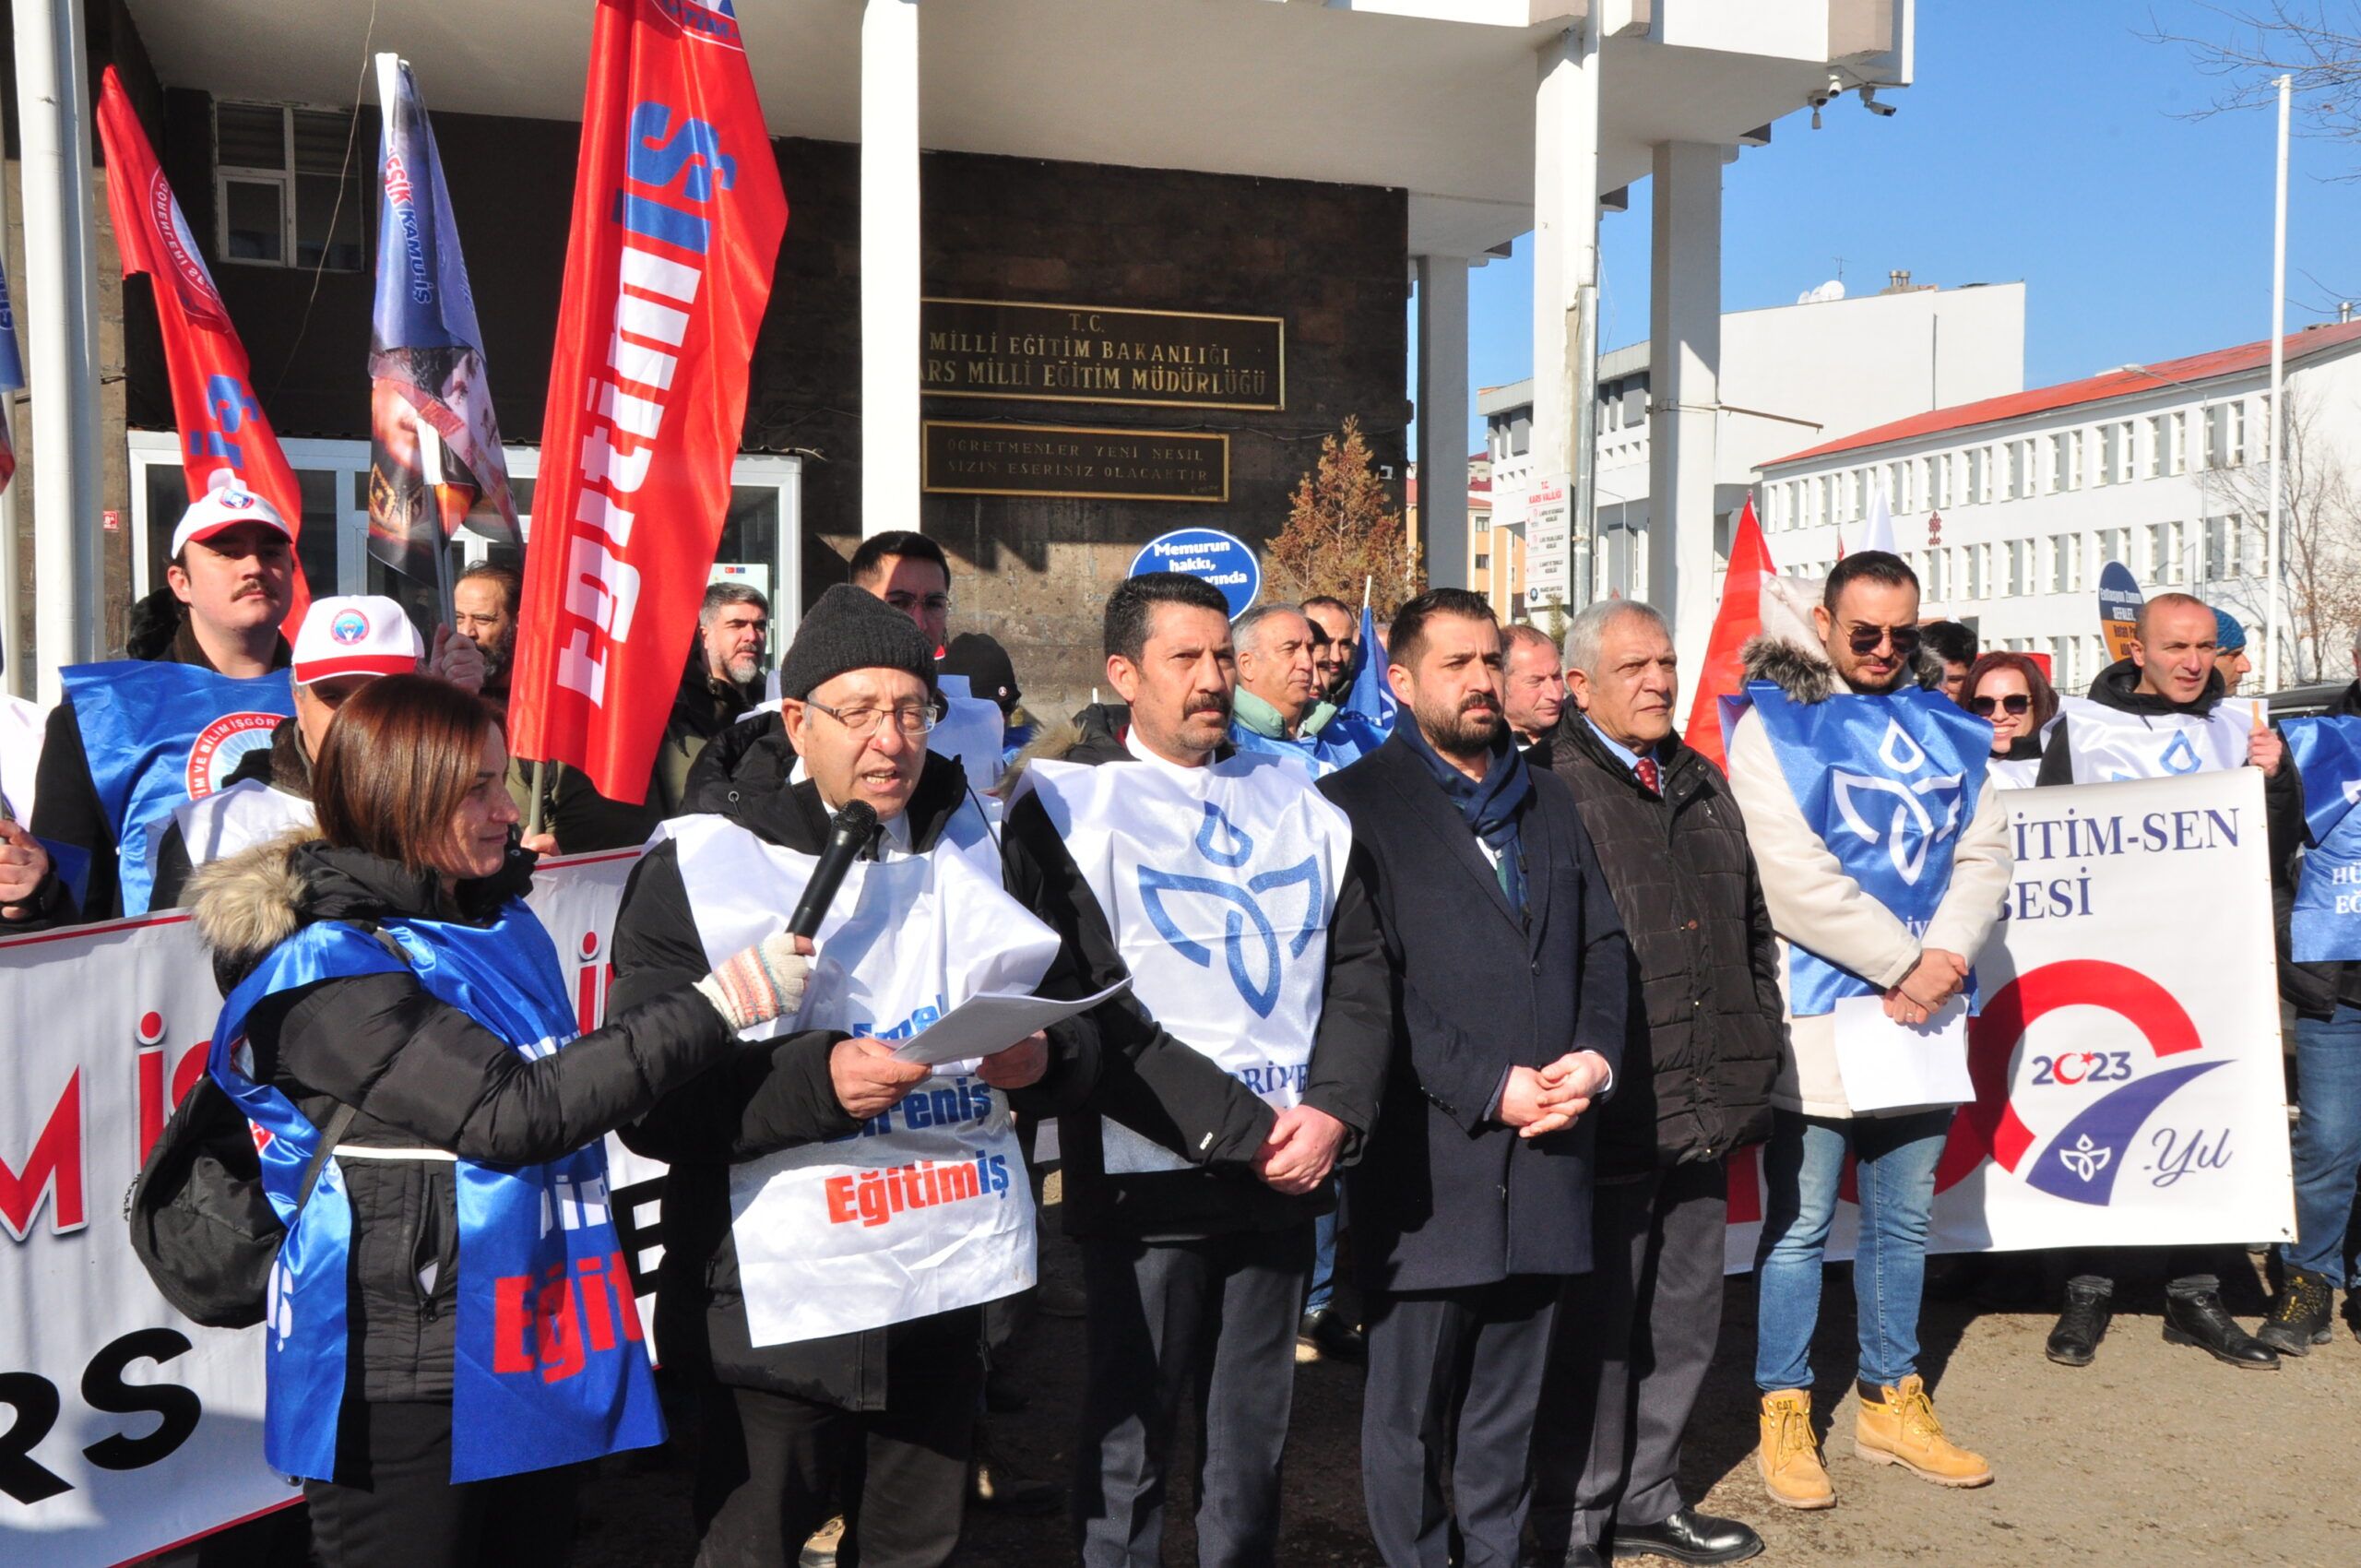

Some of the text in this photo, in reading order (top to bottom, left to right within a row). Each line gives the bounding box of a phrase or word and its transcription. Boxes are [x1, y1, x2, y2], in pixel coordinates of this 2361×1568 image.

[929, 330, 1230, 366] MİLLİ EĞİTİM BAKANLIĞI
[921, 356, 1266, 397] RS MİLLİ EĞİTİM MÜDÜRLÜĞÜ
[1154, 540, 1230, 557] Memurun
[1169, 557, 1216, 572] hakkı,
[194, 756, 208, 773] VE
[229, 716, 280, 730] İŞGÖR
